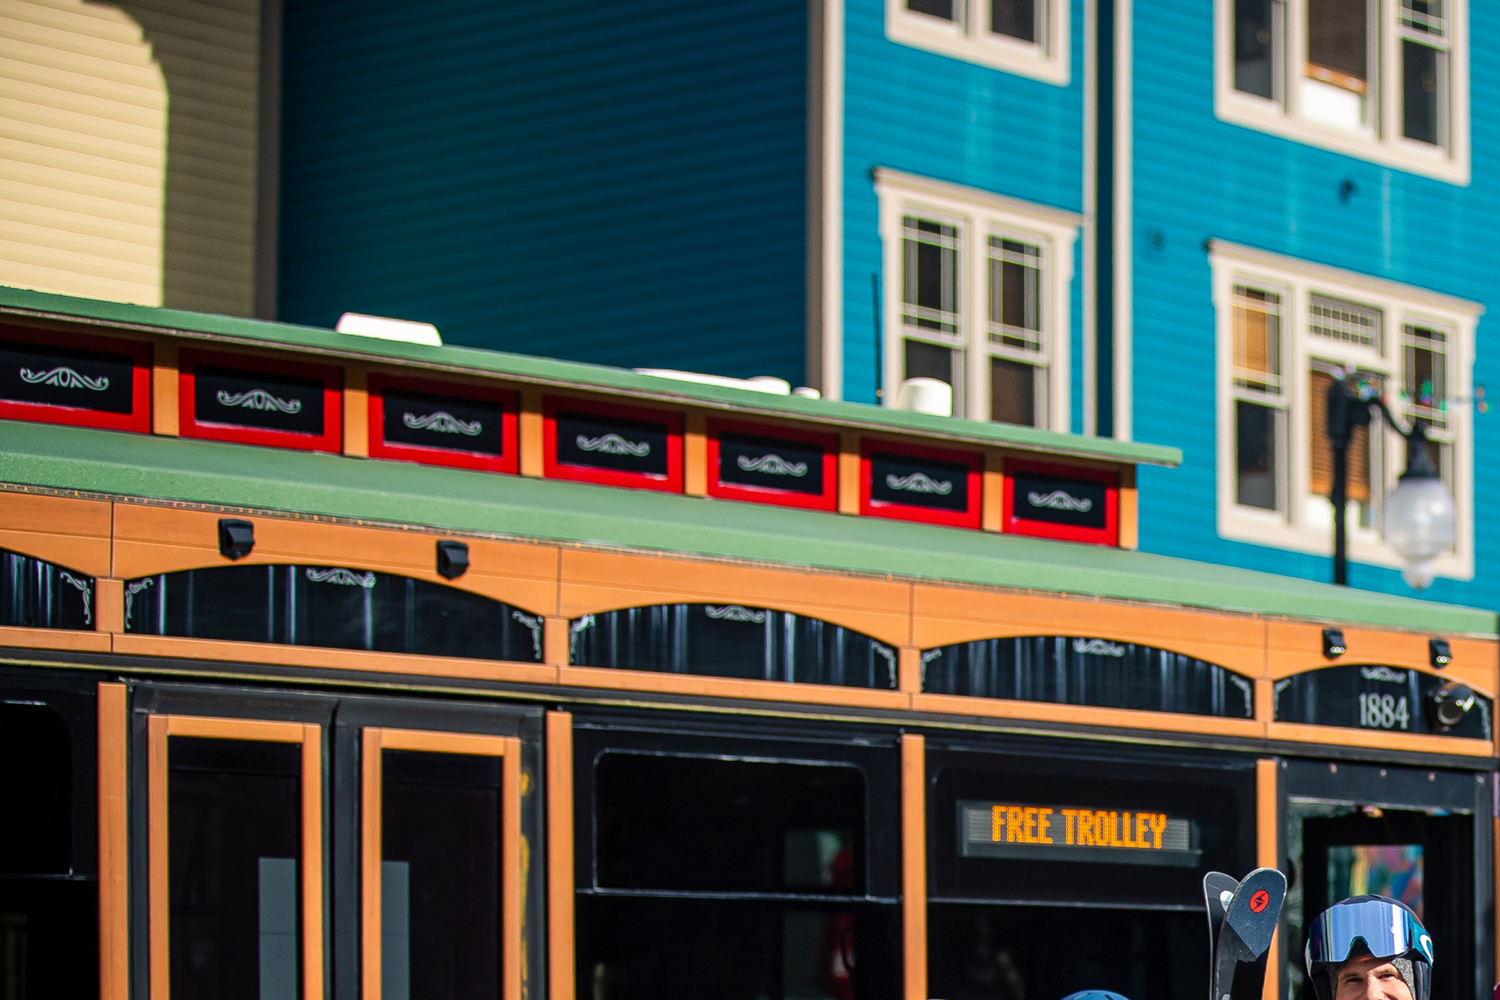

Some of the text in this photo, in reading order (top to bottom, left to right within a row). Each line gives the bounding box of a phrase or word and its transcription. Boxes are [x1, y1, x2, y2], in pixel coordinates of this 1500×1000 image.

[1359, 691, 1409, 731] 1884
[991, 804, 1167, 849] FREE TROLLEY
